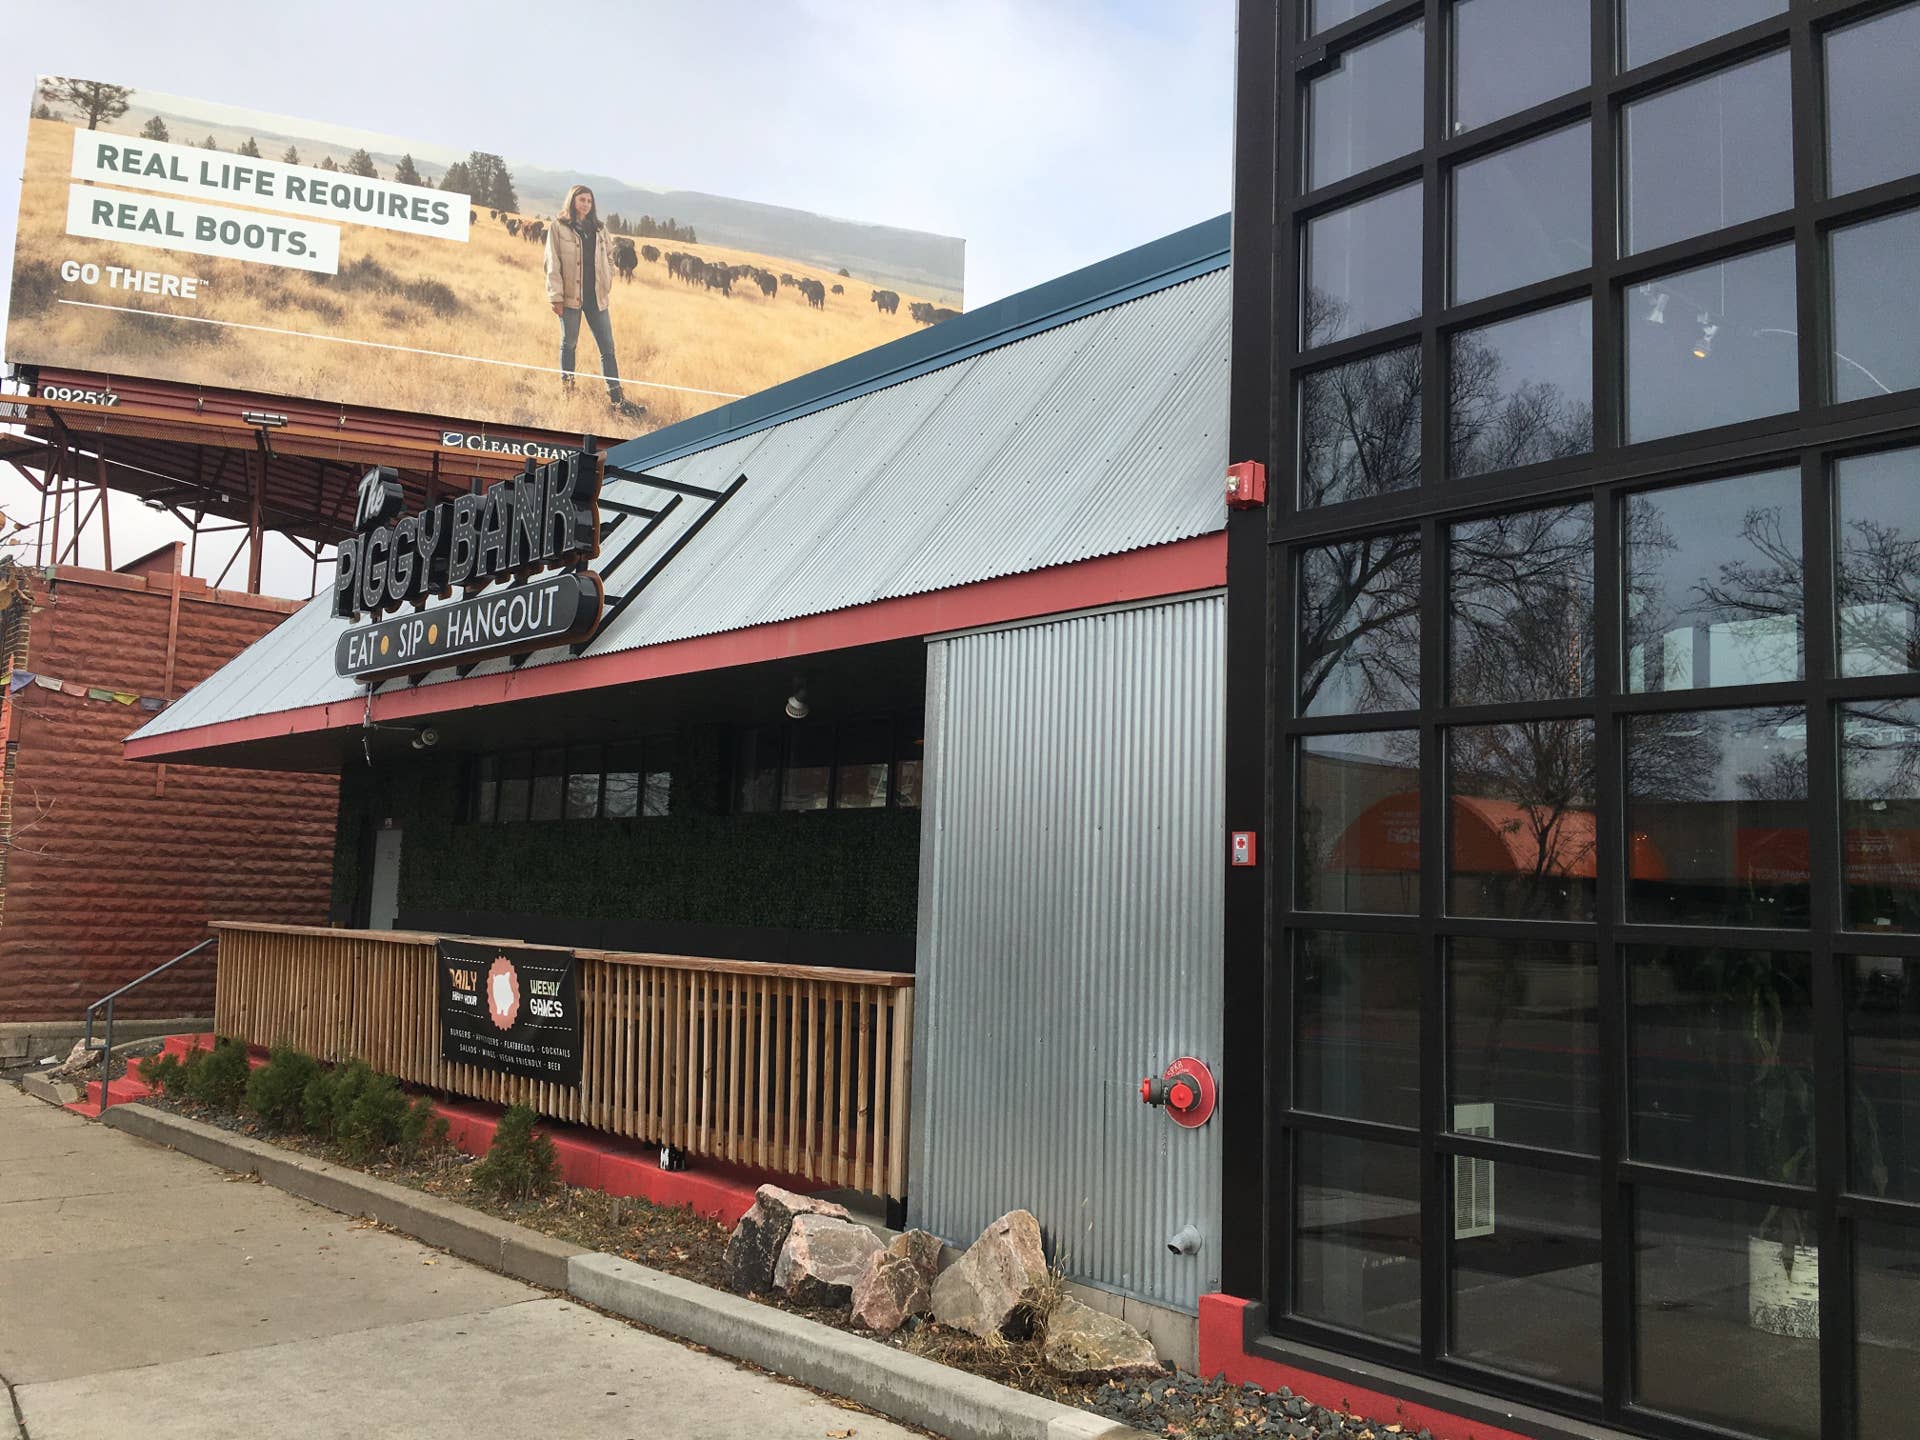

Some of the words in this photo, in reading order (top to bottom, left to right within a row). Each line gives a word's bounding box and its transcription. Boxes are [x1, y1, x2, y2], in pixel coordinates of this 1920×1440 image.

[97, 143, 189, 182] REAL
[200, 161, 274, 196] LIFE
[286, 175, 449, 225] REQUIRES
[92, 200, 184, 238] REAL
[196, 214, 317, 258] BOOTS.
[61, 260, 99, 285] GO
[466, 435, 577, 461] CLEARCHAN
[354, 466, 387, 530] The
[331, 504, 444, 619] PIGGY
[449, 452, 580, 585] BANK
[348, 631, 379, 669] EAT
[398, 620, 424, 658] SIP
[446, 586, 559, 648] HANGOUT
[530, 998, 563, 1018] GAMES
[450, 1028, 471, 1039] BURGERS
[541, 1046, 571, 1058] COCKTAILS
[548, 1061, 561, 1071] BEER
